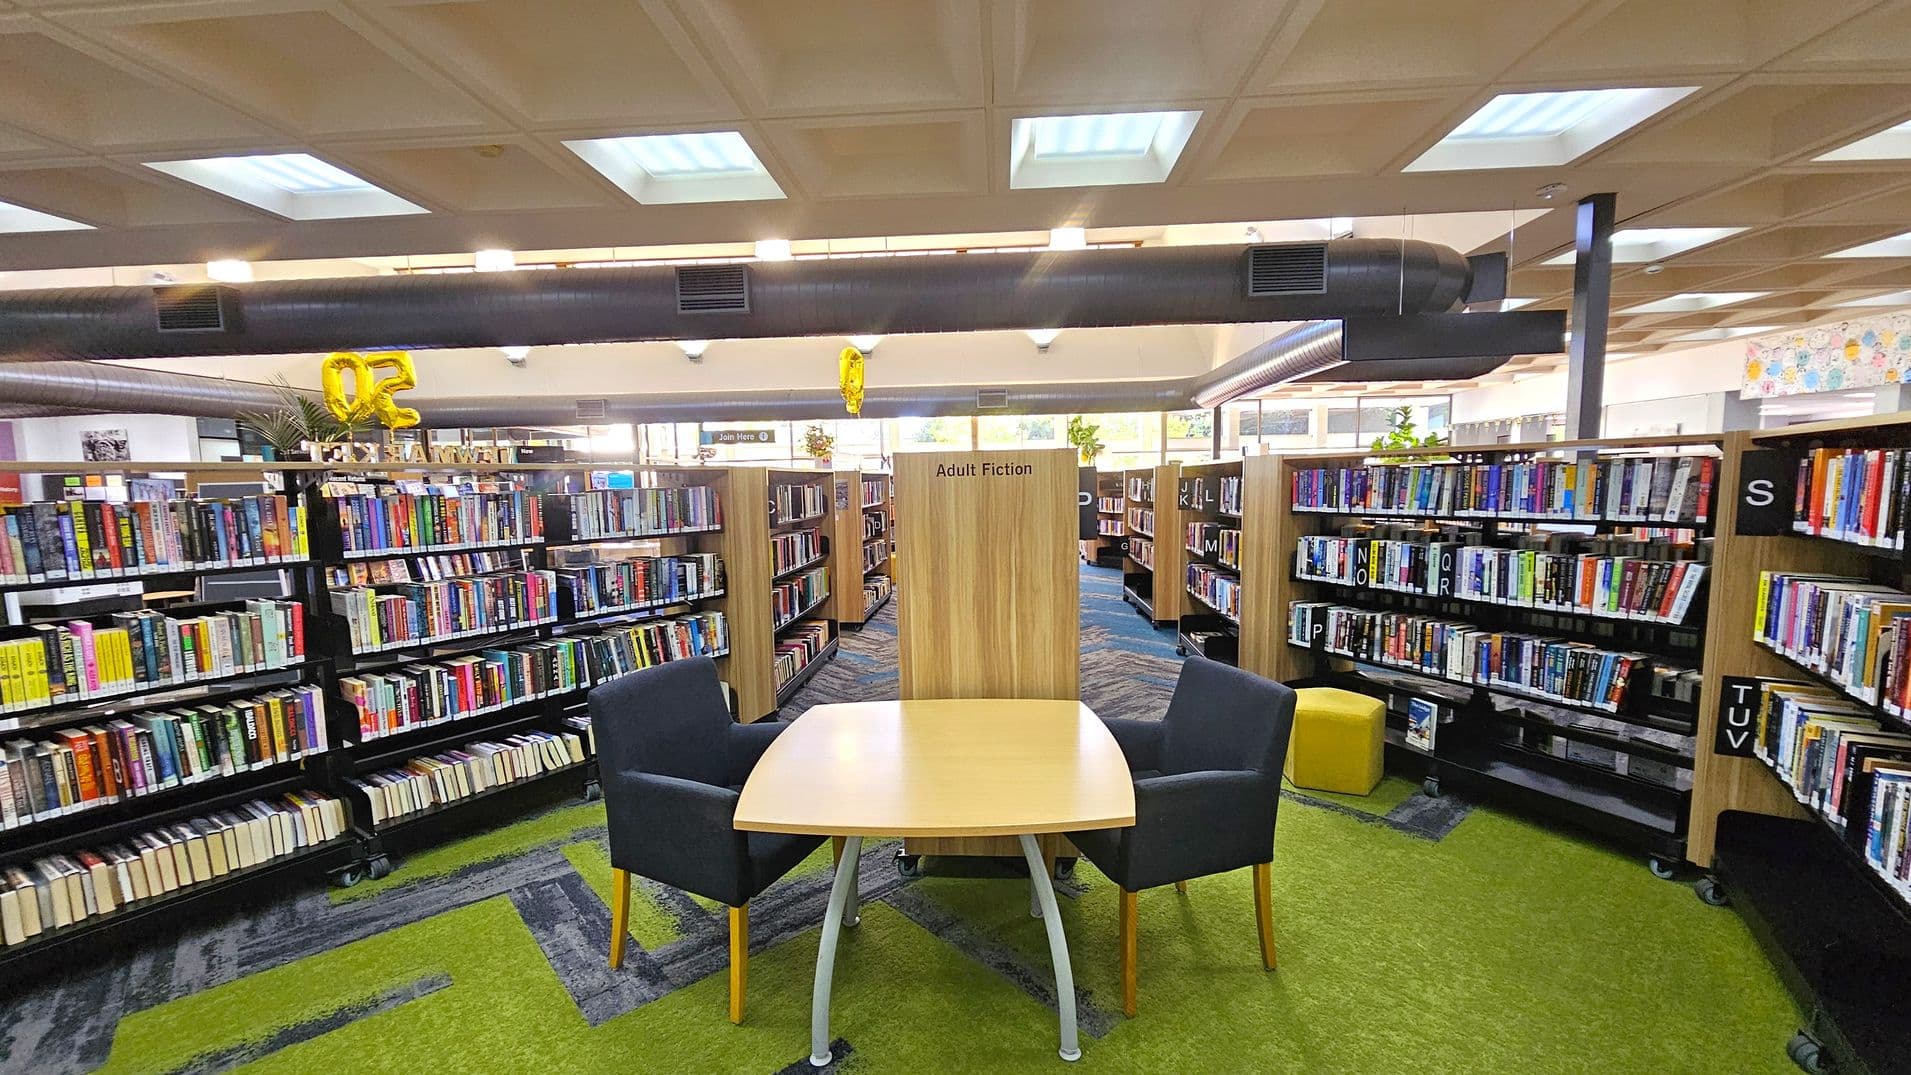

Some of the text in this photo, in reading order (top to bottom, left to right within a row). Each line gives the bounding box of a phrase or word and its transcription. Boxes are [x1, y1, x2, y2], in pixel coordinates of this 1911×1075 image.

[718, 432, 755, 441] Join Here
[936, 462, 1032, 477] Adult Fiction
[1181, 481, 1188, 493] J
[1205, 489, 1214, 502] L
[1744, 479, 1775, 506] S
[1179, 494, 1189, 506] K
[873, 521, 881, 530] D
[1120, 541, 1129, 550] G
[1205, 539, 1218, 552] M
[1358, 547, 1368, 564] N
[1441, 553, 1452, 572] Q
[1356, 568, 1367, 585] O
[1440, 577, 1450, 596] R
[1312, 623, 1323, 640] P
[1731, 684, 1753, 704] T
[1728, 706, 1751, 727] U
[1725, 729, 1750, 749] V
